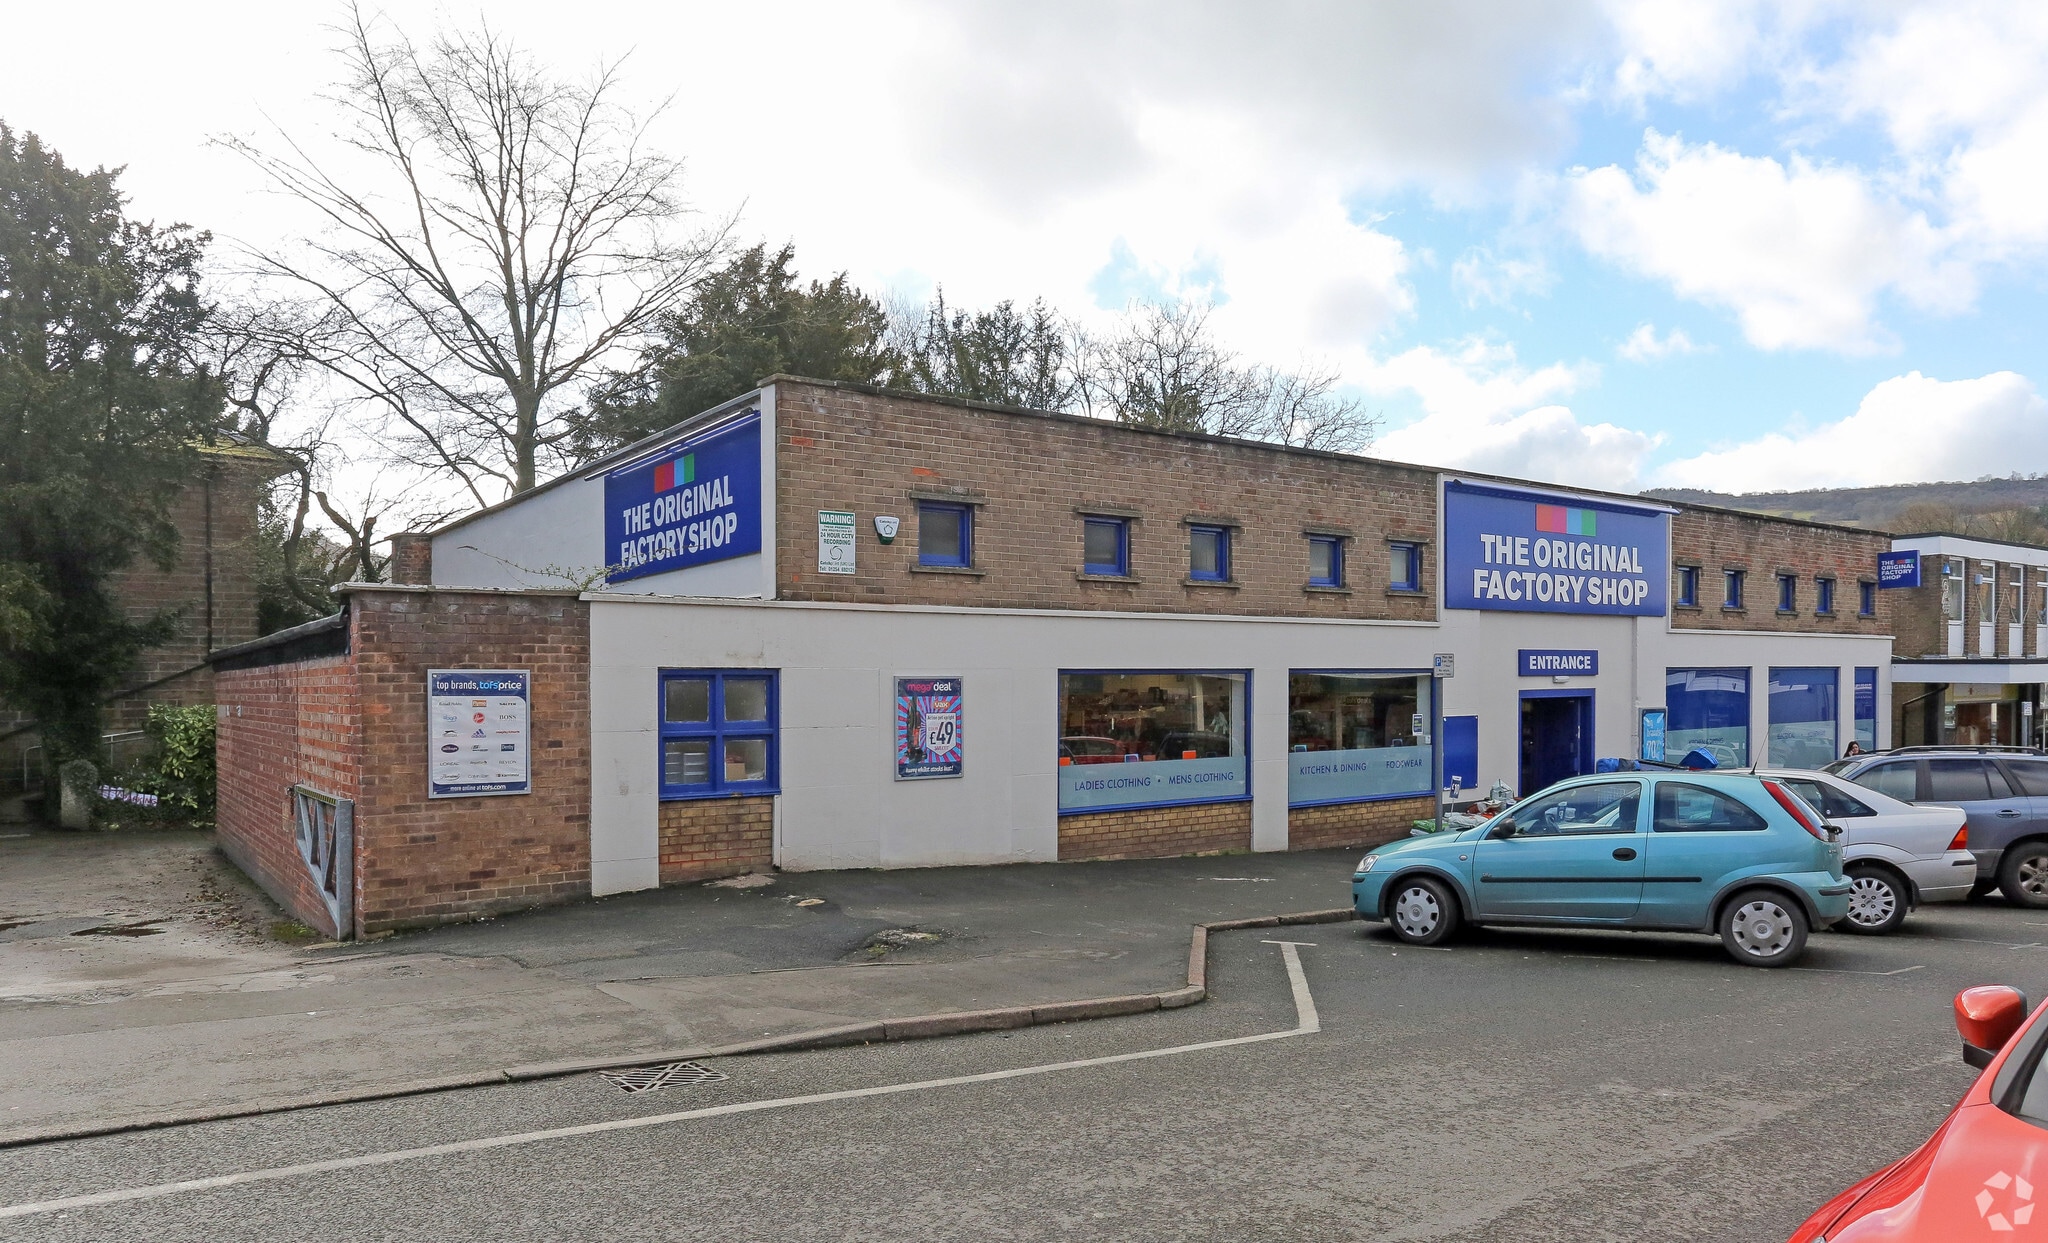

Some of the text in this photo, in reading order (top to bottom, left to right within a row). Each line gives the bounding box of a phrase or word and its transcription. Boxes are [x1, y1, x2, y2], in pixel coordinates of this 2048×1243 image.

[623, 475, 734, 536] THE ORIGINAL
[820, 514, 854, 525] WARNING!
[621, 512, 738, 568] FACTORY SHOP
[1480, 534, 1643, 574] THE ORIGINAL
[1473, 569, 1648, 606] FACTORY SHOP
[1529, 655, 1591, 670] ENTRANCE
[436, 680, 448, 691] top
[451, 680, 478, 690] brands,
[930, 722, 954, 744] £49
[1300, 765, 1331, 775] KITCHEN
[1341, 763, 1367, 772] DINING
[1386, 759, 1422, 769] FOOTWEAR
[1074, 772, 1234, 791] LADIES CLOTHING MENS CLOTHING
